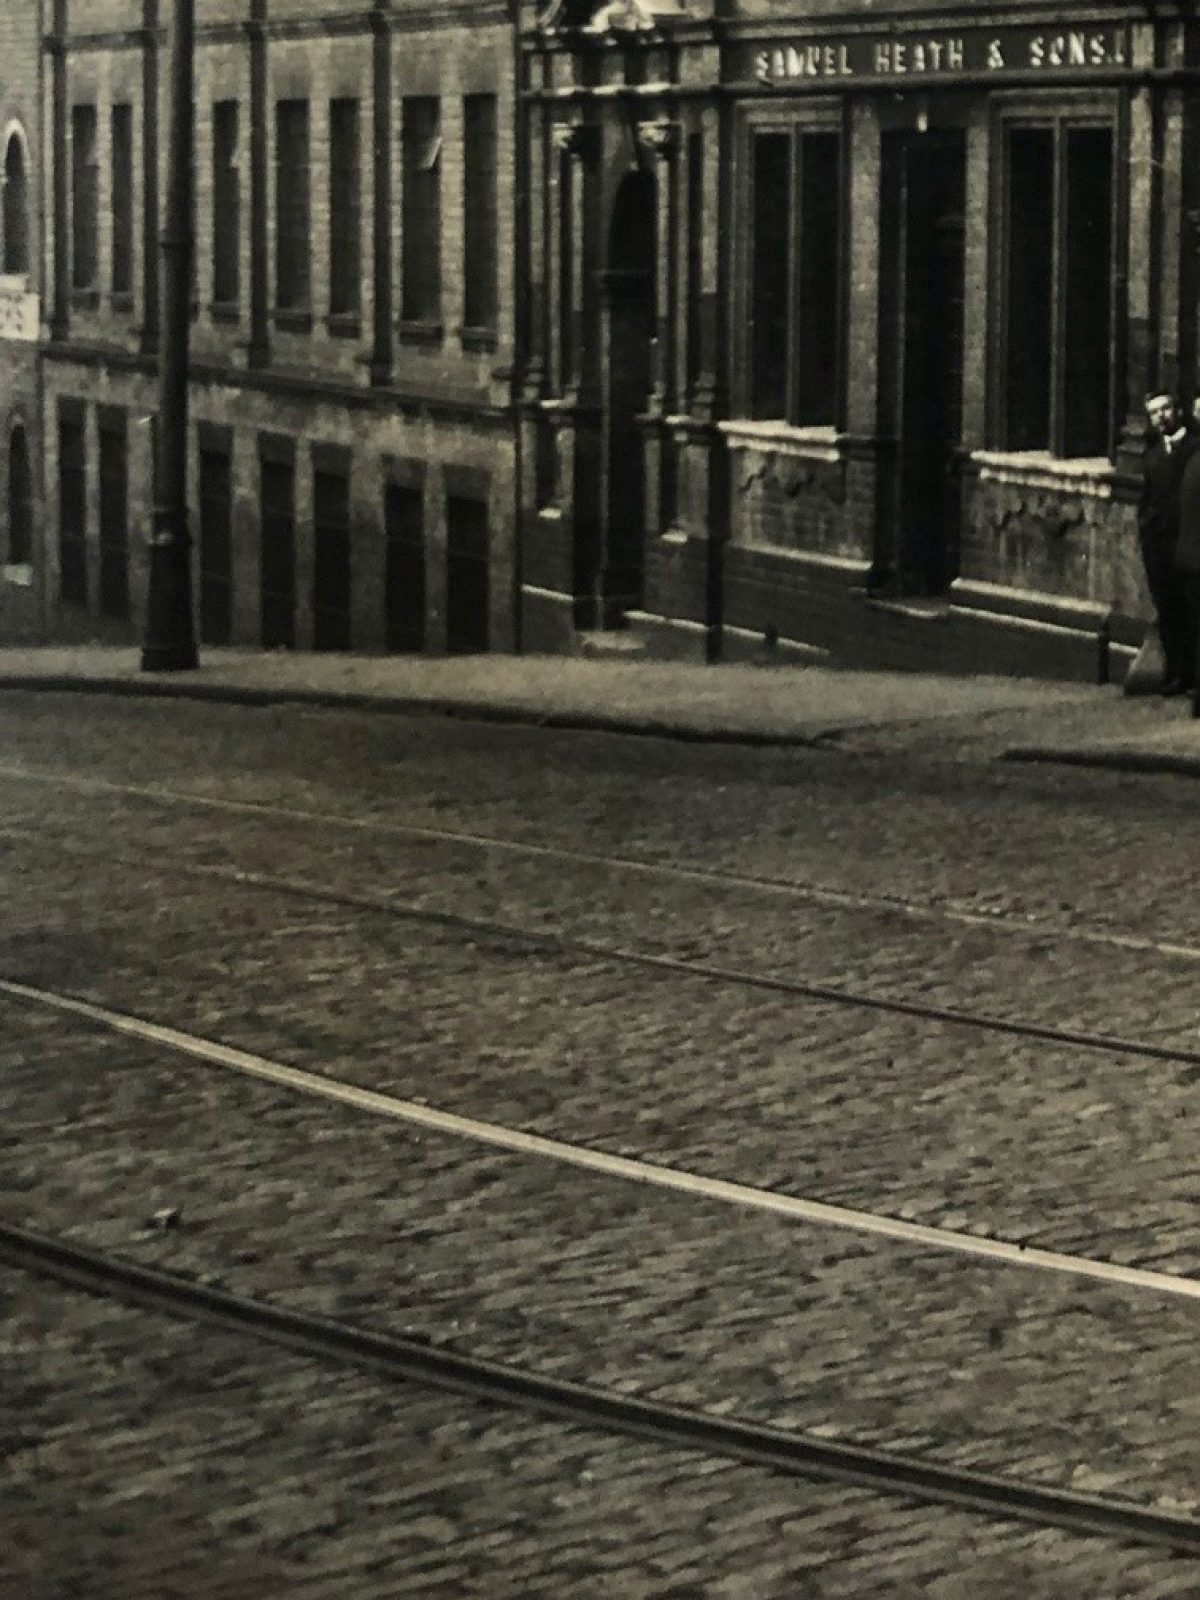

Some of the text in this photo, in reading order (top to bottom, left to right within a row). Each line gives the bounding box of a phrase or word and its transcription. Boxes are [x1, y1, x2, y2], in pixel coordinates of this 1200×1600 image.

[755, 45, 853, 79] SAMUEL
[875, 38, 963, 74] HEATH
[987, 39, 1004, 69] &
